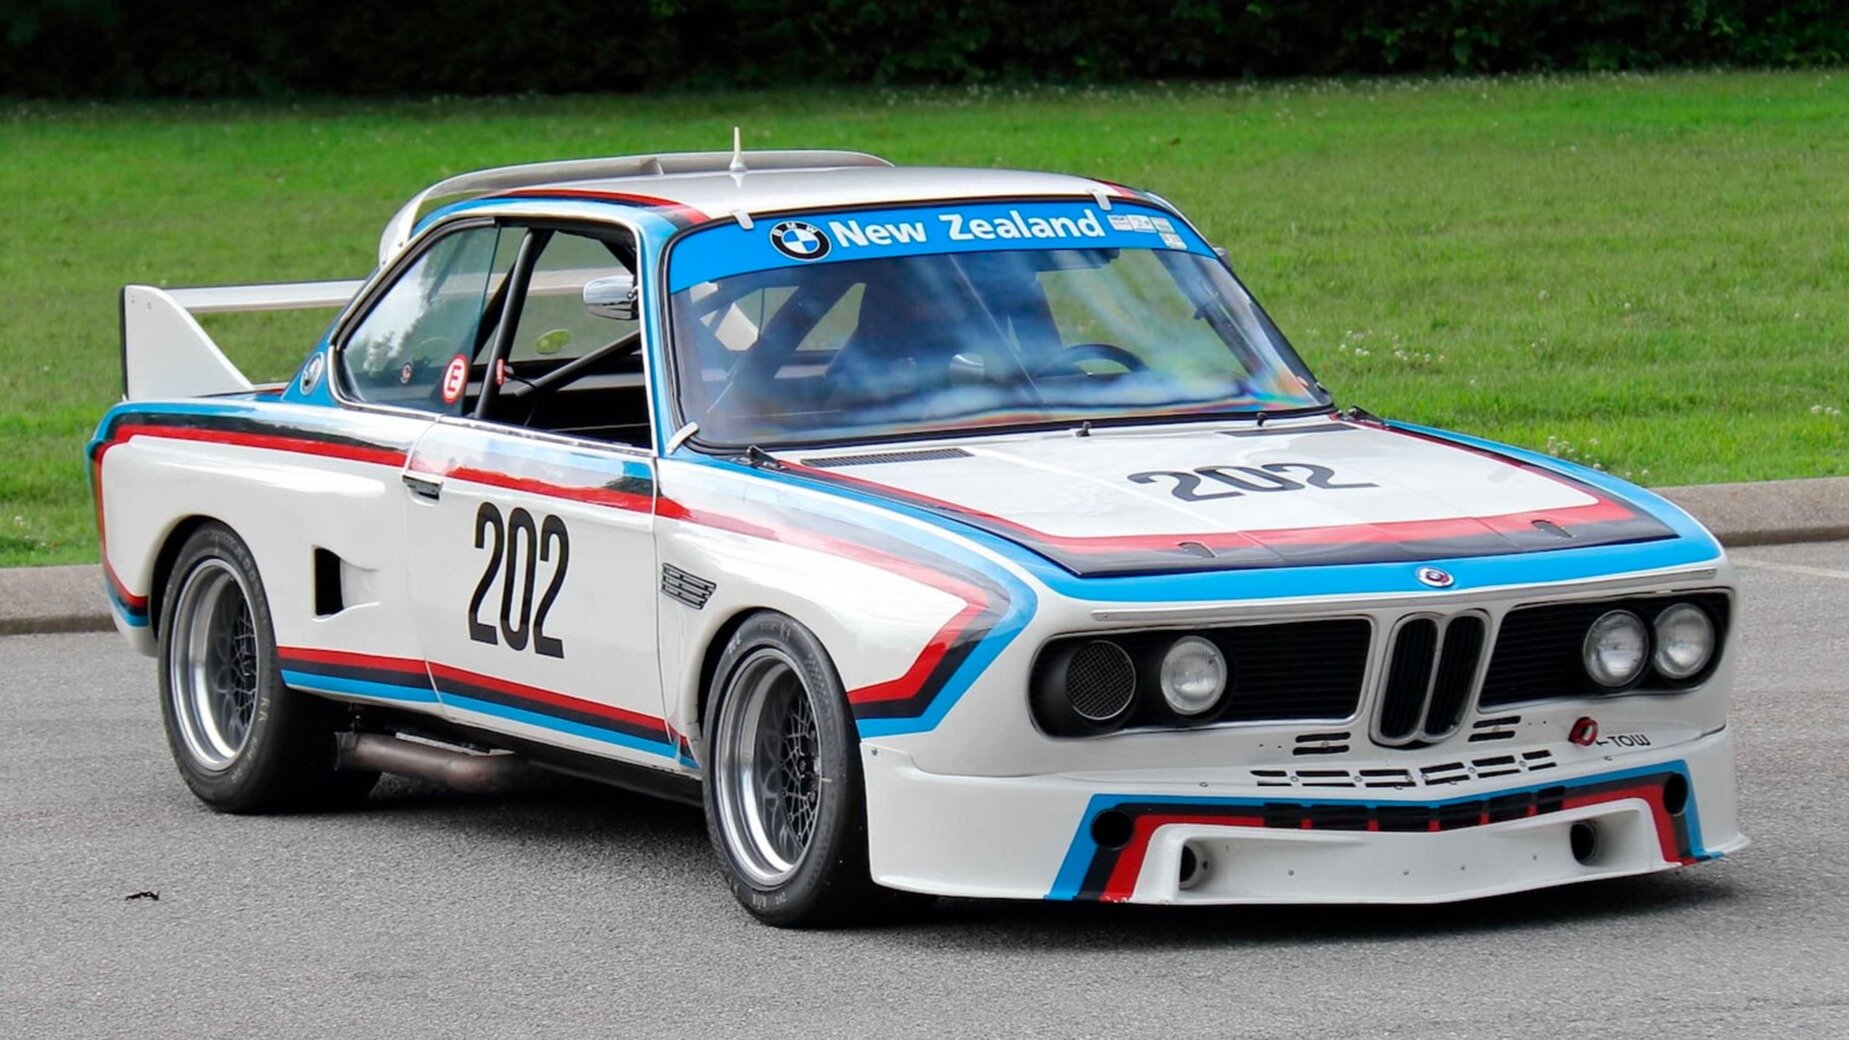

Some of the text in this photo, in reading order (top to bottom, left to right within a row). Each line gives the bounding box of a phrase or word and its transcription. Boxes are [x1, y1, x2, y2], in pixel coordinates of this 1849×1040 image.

[828, 220, 927, 248] New
[938, 208, 1106, 241] Zealand
[447, 365, 461, 392] E
[1127, 463, 1381, 501] 202
[468, 501, 569, 658] 202
[1607, 733, 1651, 748] TOW
